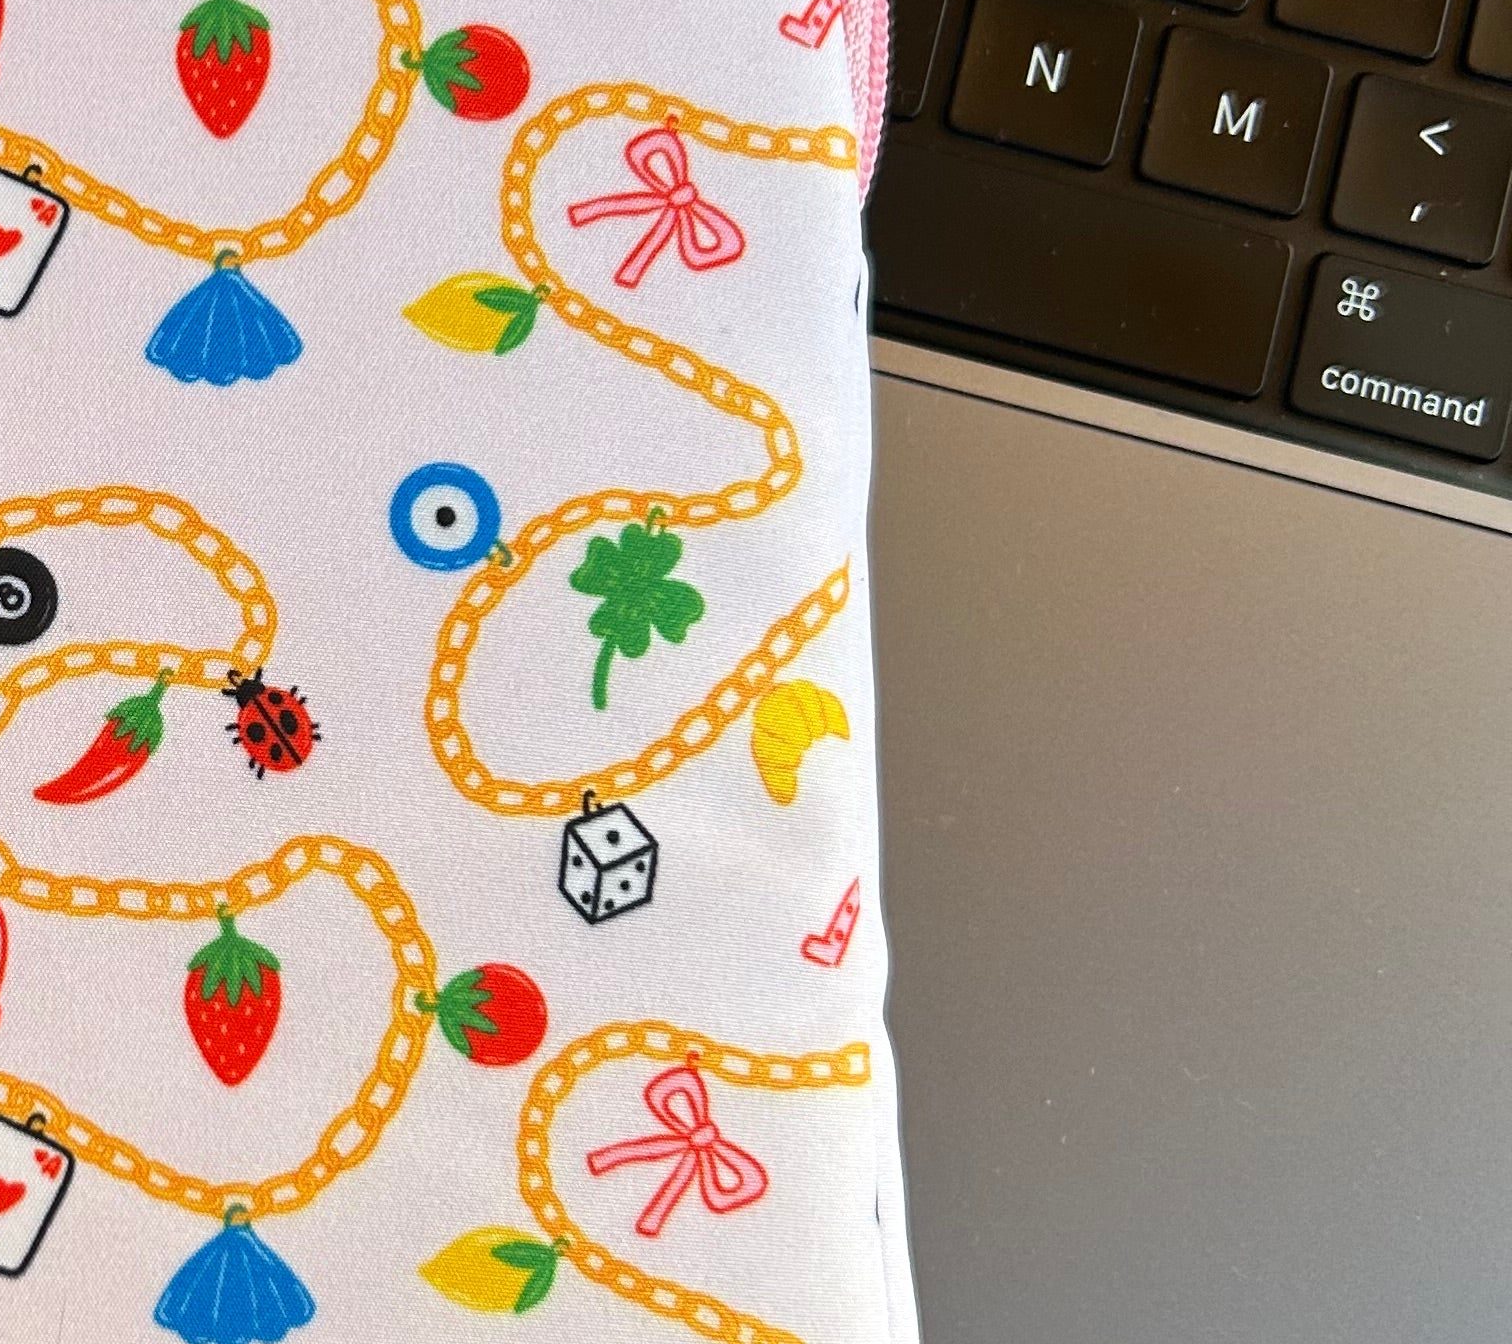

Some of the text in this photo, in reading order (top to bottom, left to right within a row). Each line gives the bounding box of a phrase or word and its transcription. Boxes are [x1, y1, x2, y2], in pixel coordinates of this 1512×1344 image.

[1025, 46, 1065, 93] N
[1212, 94, 1258, 142] M
[1419, 122, 1449, 156] <
[1321, 367, 1485, 426] command
